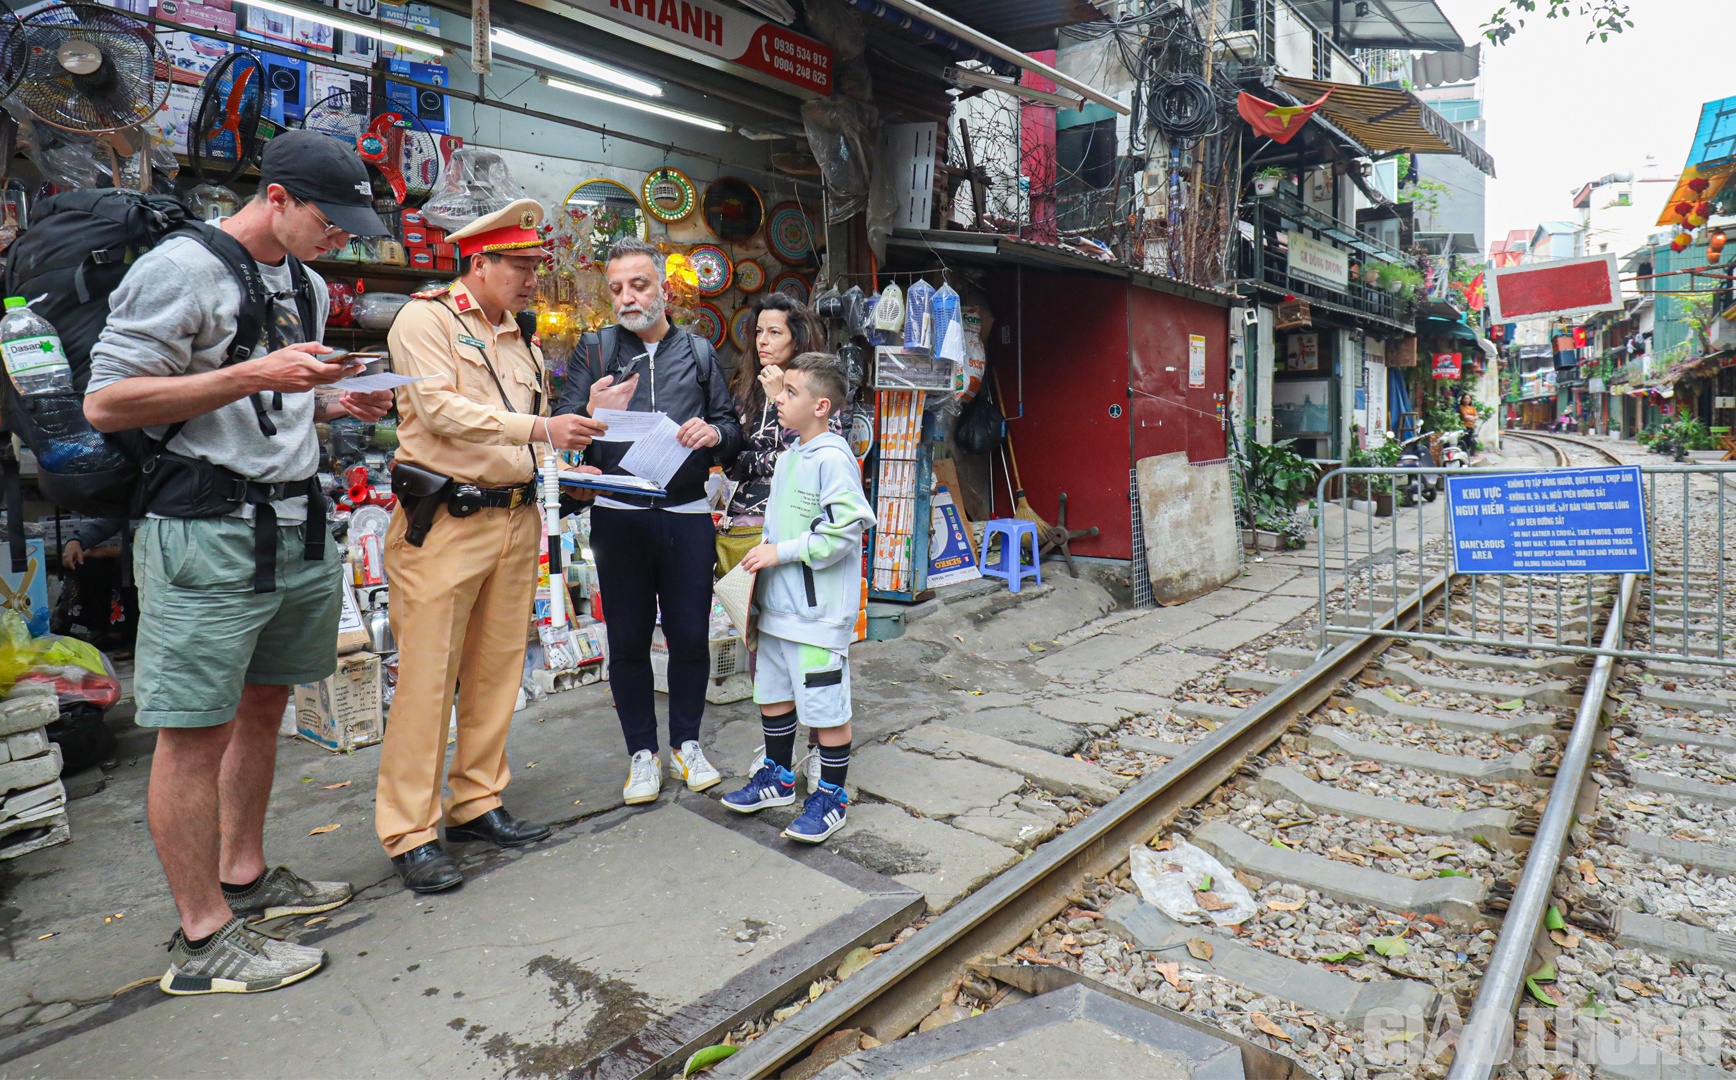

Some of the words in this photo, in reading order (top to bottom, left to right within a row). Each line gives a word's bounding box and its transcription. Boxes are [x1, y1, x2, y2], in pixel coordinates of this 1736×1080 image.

[386, 10, 430, 24] MISUKO
[774, 37, 794, 56] 0936
[796, 46, 811, 62] 534
[813, 52, 828, 68] 912
[774, 56, 794, 74] 0904
[796, 64, 810, 80] 248
[812, 70, 827, 85] 625
[1462, 488, 1481, 499] KHU
[1483, 486, 1502, 500] VỰC
[1456, 505, 1478, 516] NGUY
[1481, 500, 1504, 515] HIỂM
[1472, 551, 1493, 559] AREA
[935, 557, 962, 568] SENKO
